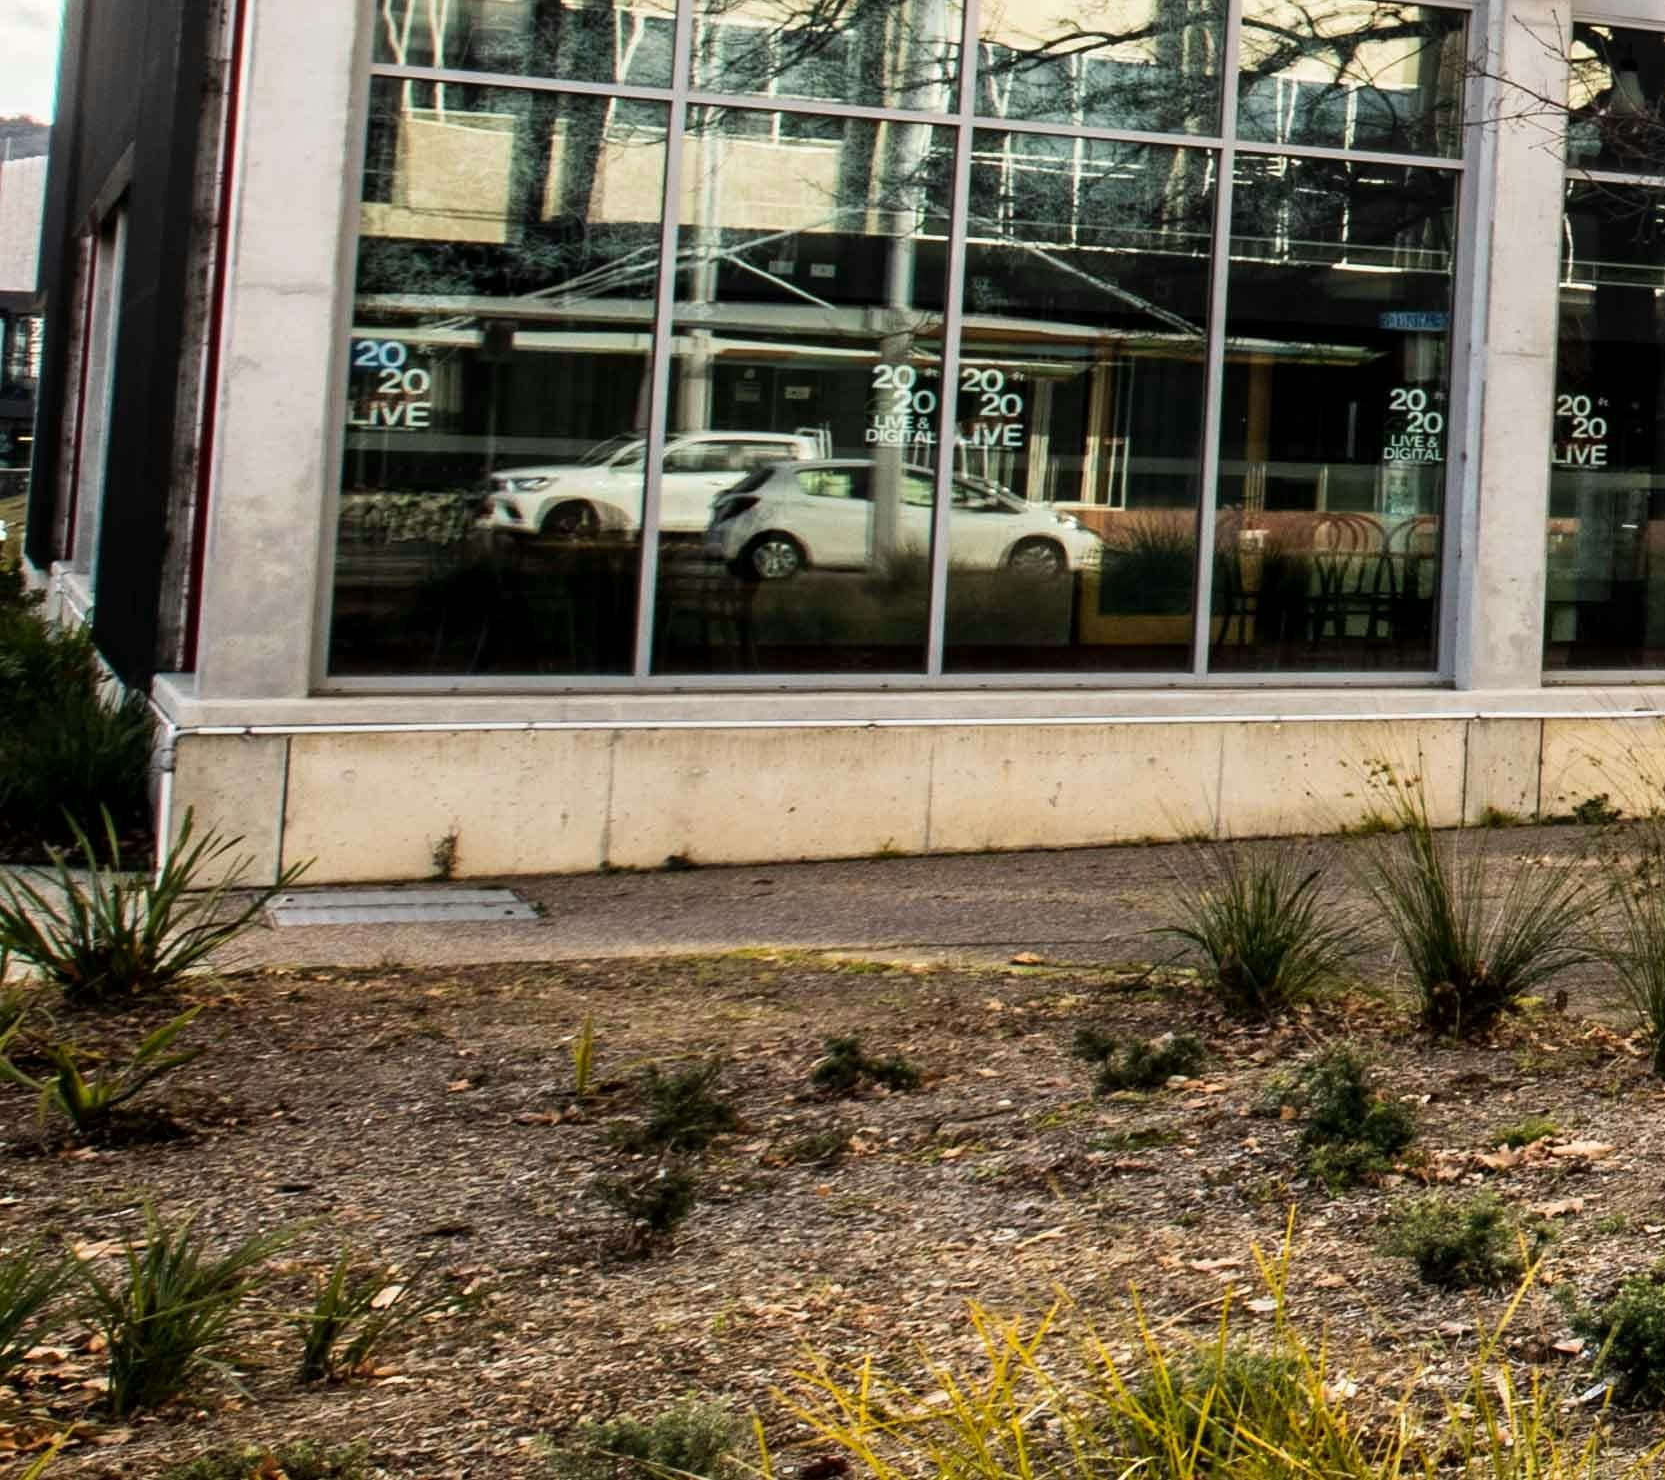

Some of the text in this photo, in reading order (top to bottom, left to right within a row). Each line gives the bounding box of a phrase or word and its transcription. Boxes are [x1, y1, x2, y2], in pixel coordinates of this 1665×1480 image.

[354, 341, 407, 367] 20
[377, 368, 431, 394] 20
[872, 364, 916, 389] 20
[961, 368, 1004, 392] 20
[893, 390, 936, 414] 20
[980, 393, 1023, 417] 20
[1389, 389, 1427, 411] 20
[1557, 395, 1591, 416] 20
[874, 415, 914, 429] LIVE
[1406, 412, 1443, 433] 20
[1572, 417, 1607, 439] 20
[1391, 435, 1424, 448] LIVE
[1552, 444, 1608, 465] LIVE
